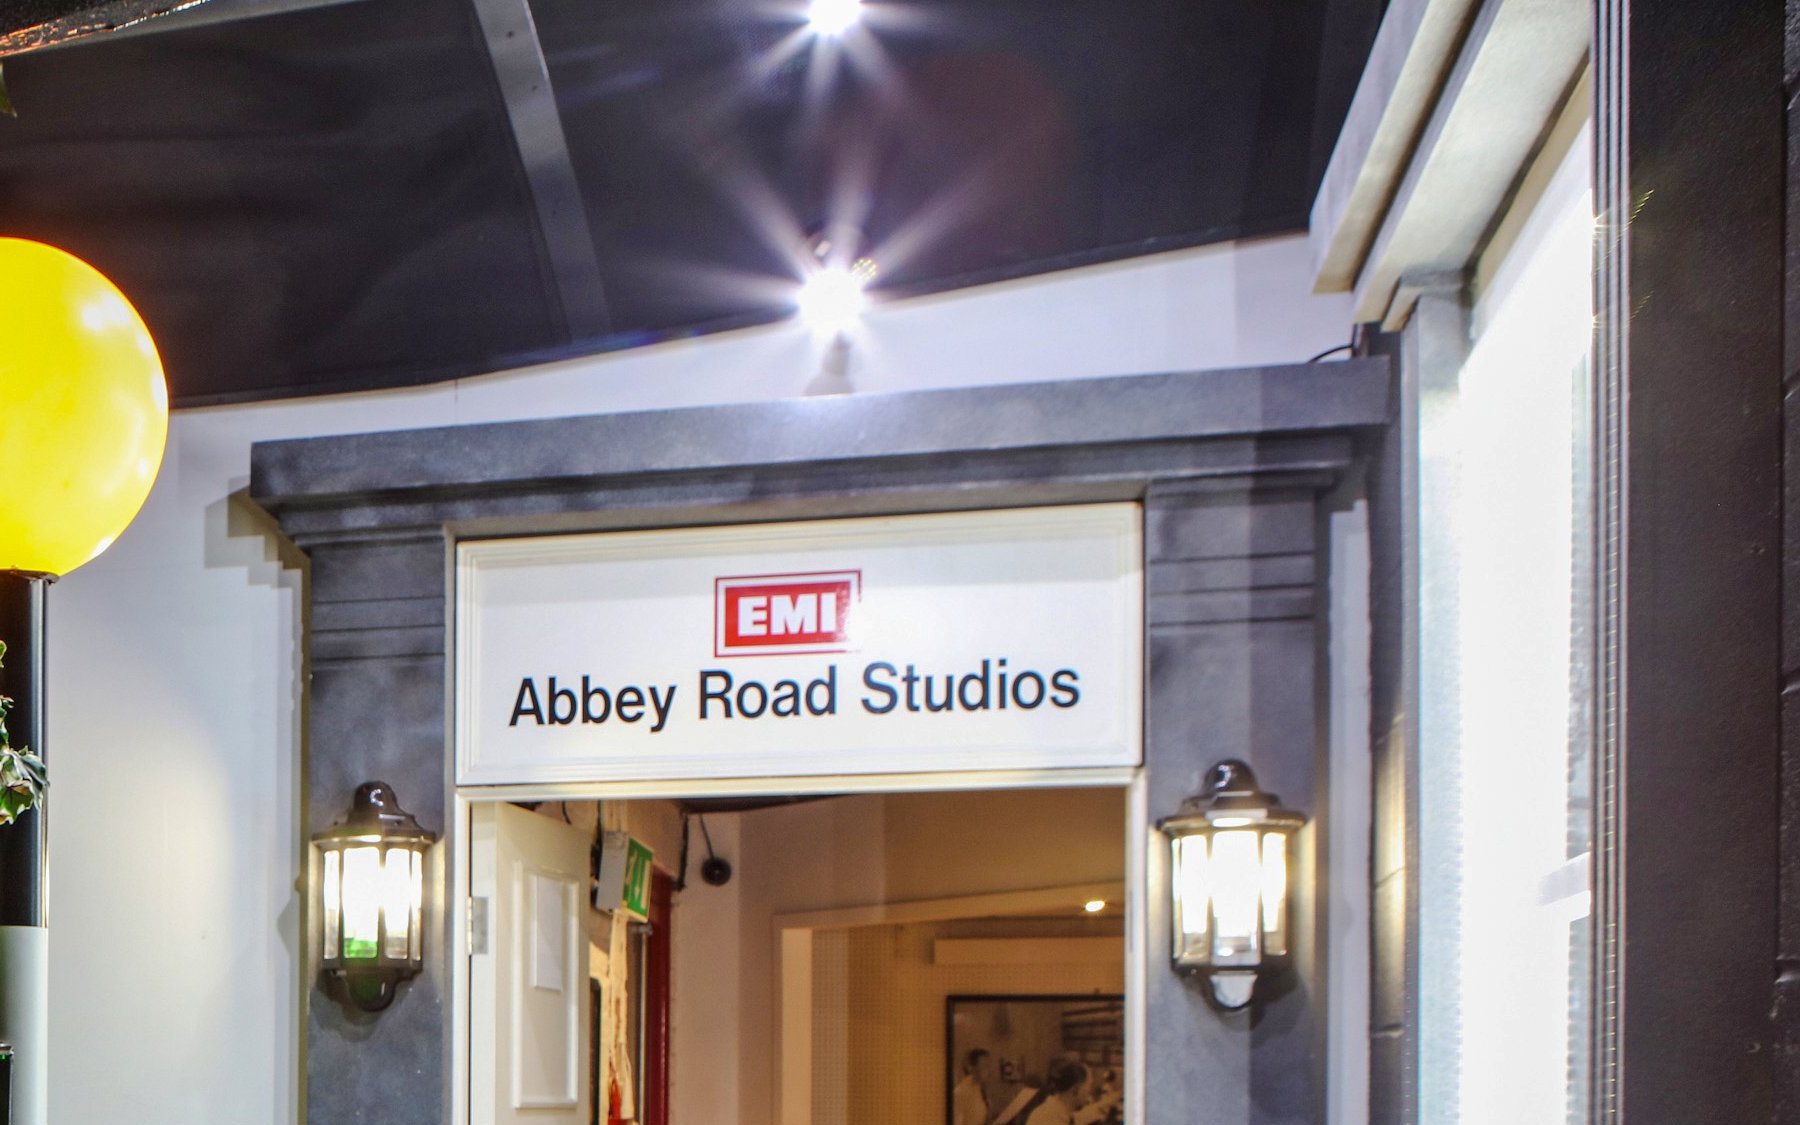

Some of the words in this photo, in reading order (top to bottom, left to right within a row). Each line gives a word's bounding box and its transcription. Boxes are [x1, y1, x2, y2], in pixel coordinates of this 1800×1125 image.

[737, 592, 838, 638] EMI
[508, 674, 677, 733] Abbey
[699, 665, 838, 720] Road
[861, 657, 1082, 716] Studios
